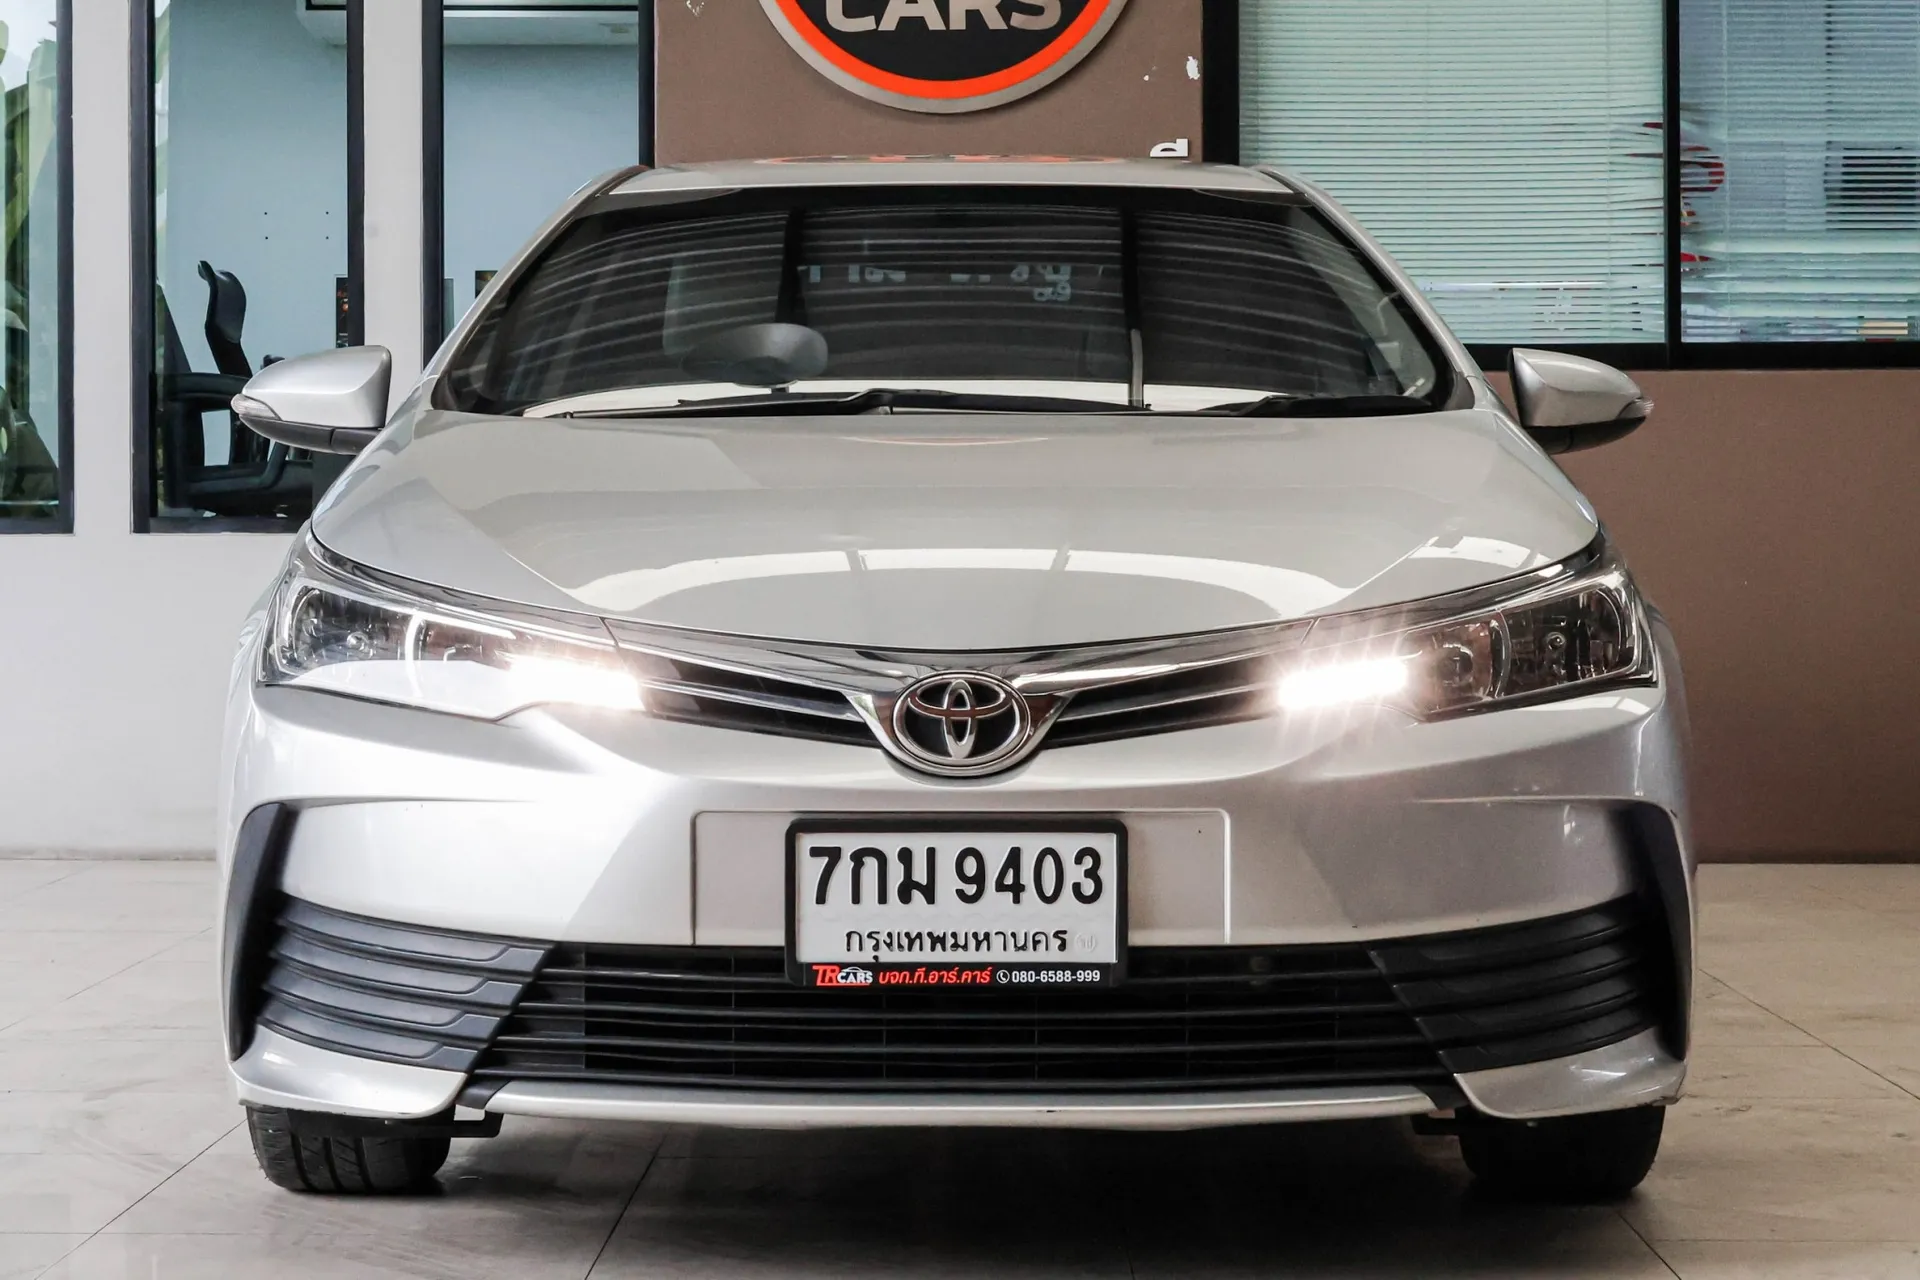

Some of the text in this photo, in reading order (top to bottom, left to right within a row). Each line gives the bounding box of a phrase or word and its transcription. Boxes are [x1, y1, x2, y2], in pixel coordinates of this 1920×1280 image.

[809, 846, 1103, 905] 7กม 9403
[845, 929, 1068, 962] กรุงเทพมหานคร
[1011, 969, 1101, 983] 080-6588-999
